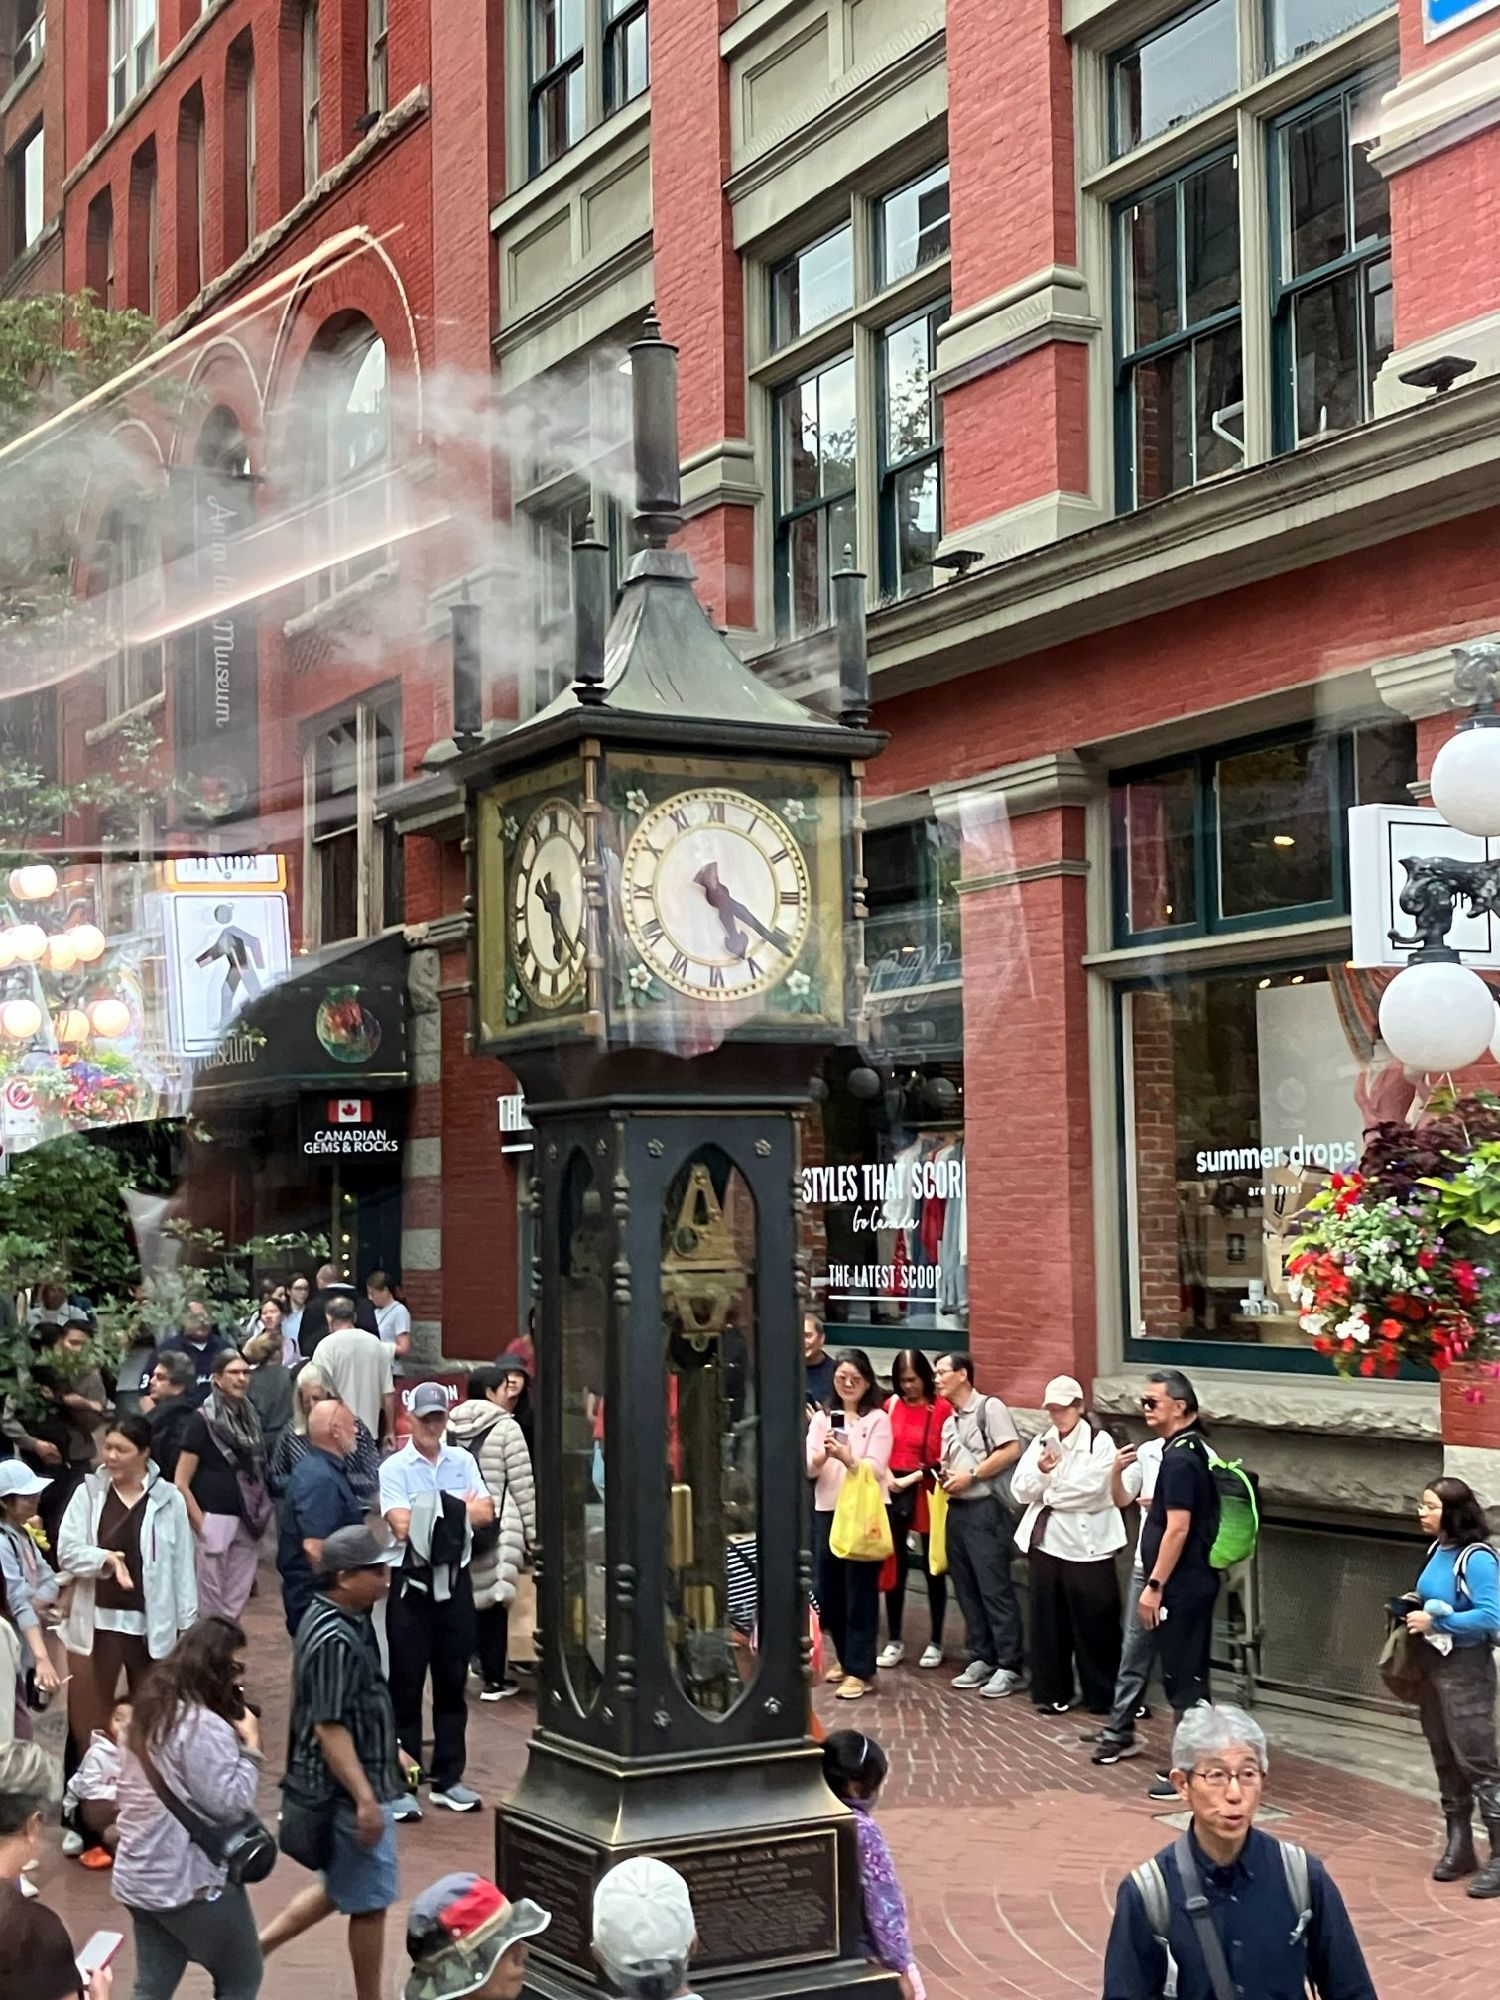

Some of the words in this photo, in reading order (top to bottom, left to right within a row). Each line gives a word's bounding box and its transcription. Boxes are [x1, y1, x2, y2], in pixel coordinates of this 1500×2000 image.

[212, 619, 235, 729] Museum
[303, 1141, 340, 1154] GEMS
[342, 1141, 352, 1153] &
[354, 1140, 399, 1152] ROCKS
[314, 1129, 387, 1142] CANADIAN
[1196, 1145, 1283, 1173] summer
[1289, 1134, 1357, 1174] drops
[801, 1165, 858, 1203] STYLES
[861, 1162, 907, 1201] THAT
[828, 1264, 850, 1287] THE
[854, 1264, 897, 1288] LATEST
[901, 1264, 942, 1289] SCOOP
